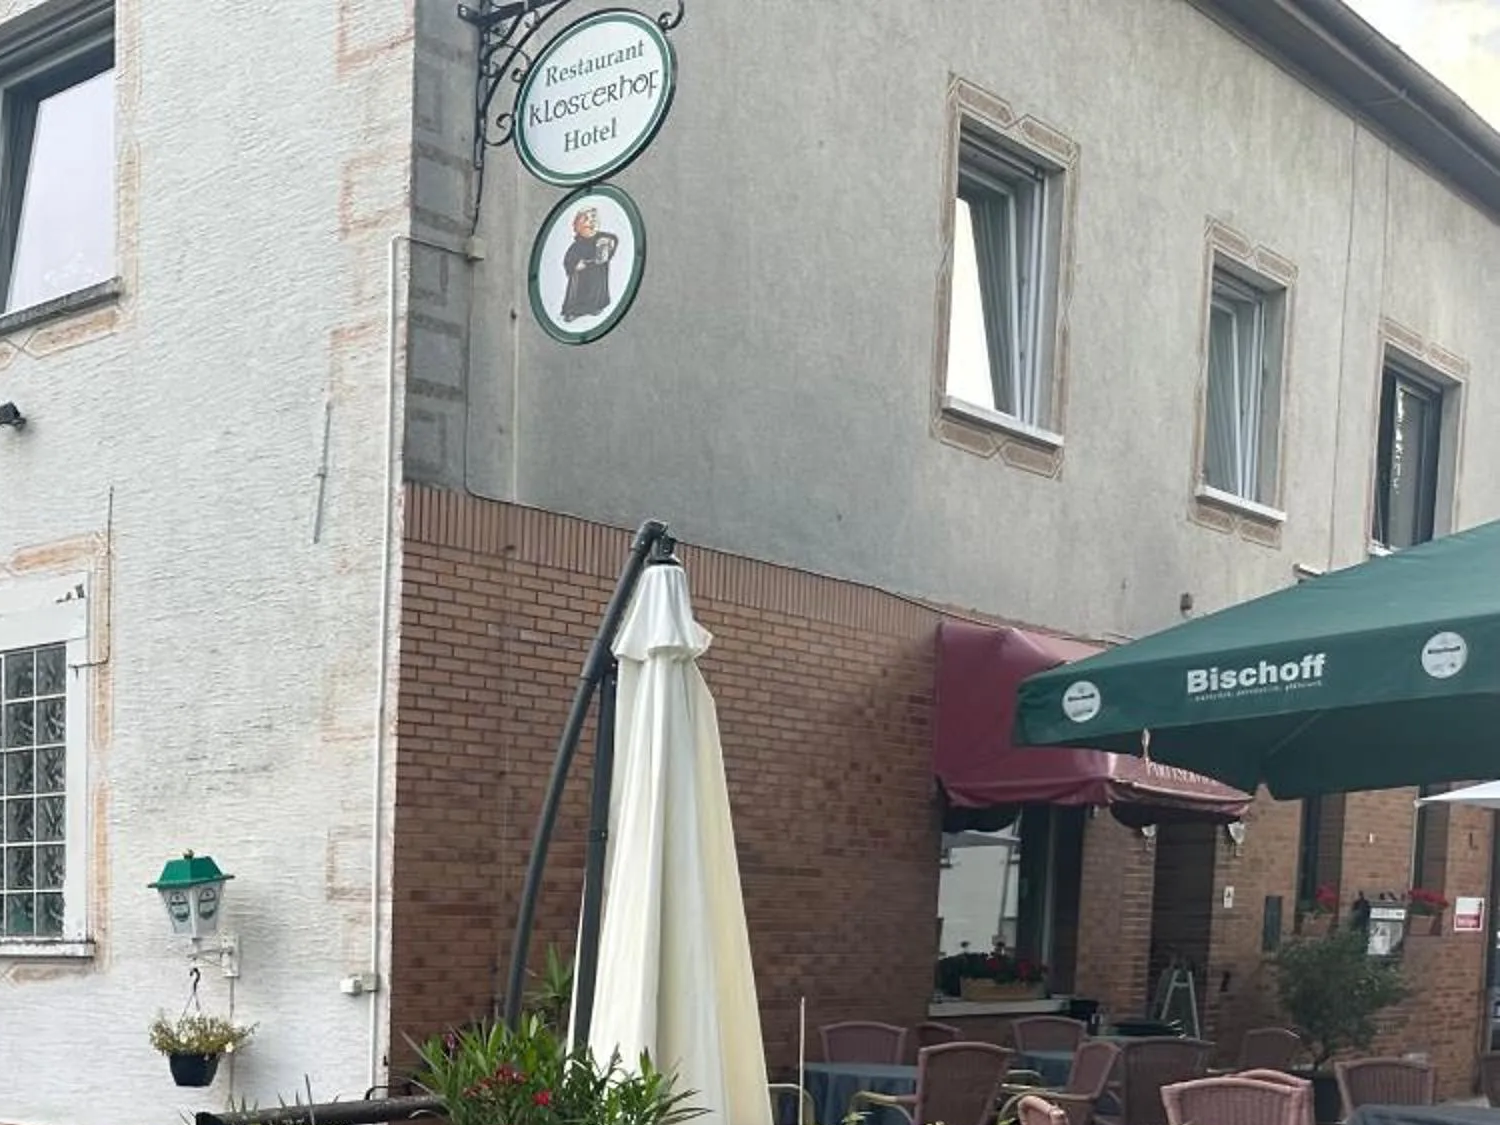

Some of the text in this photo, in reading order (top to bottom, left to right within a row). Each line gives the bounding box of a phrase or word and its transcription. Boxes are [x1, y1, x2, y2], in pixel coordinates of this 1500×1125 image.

[545, 39, 644, 87] Restaurant
[564, 117, 617, 152] Hotel
[1187, 653, 1326, 693] Bischoff
